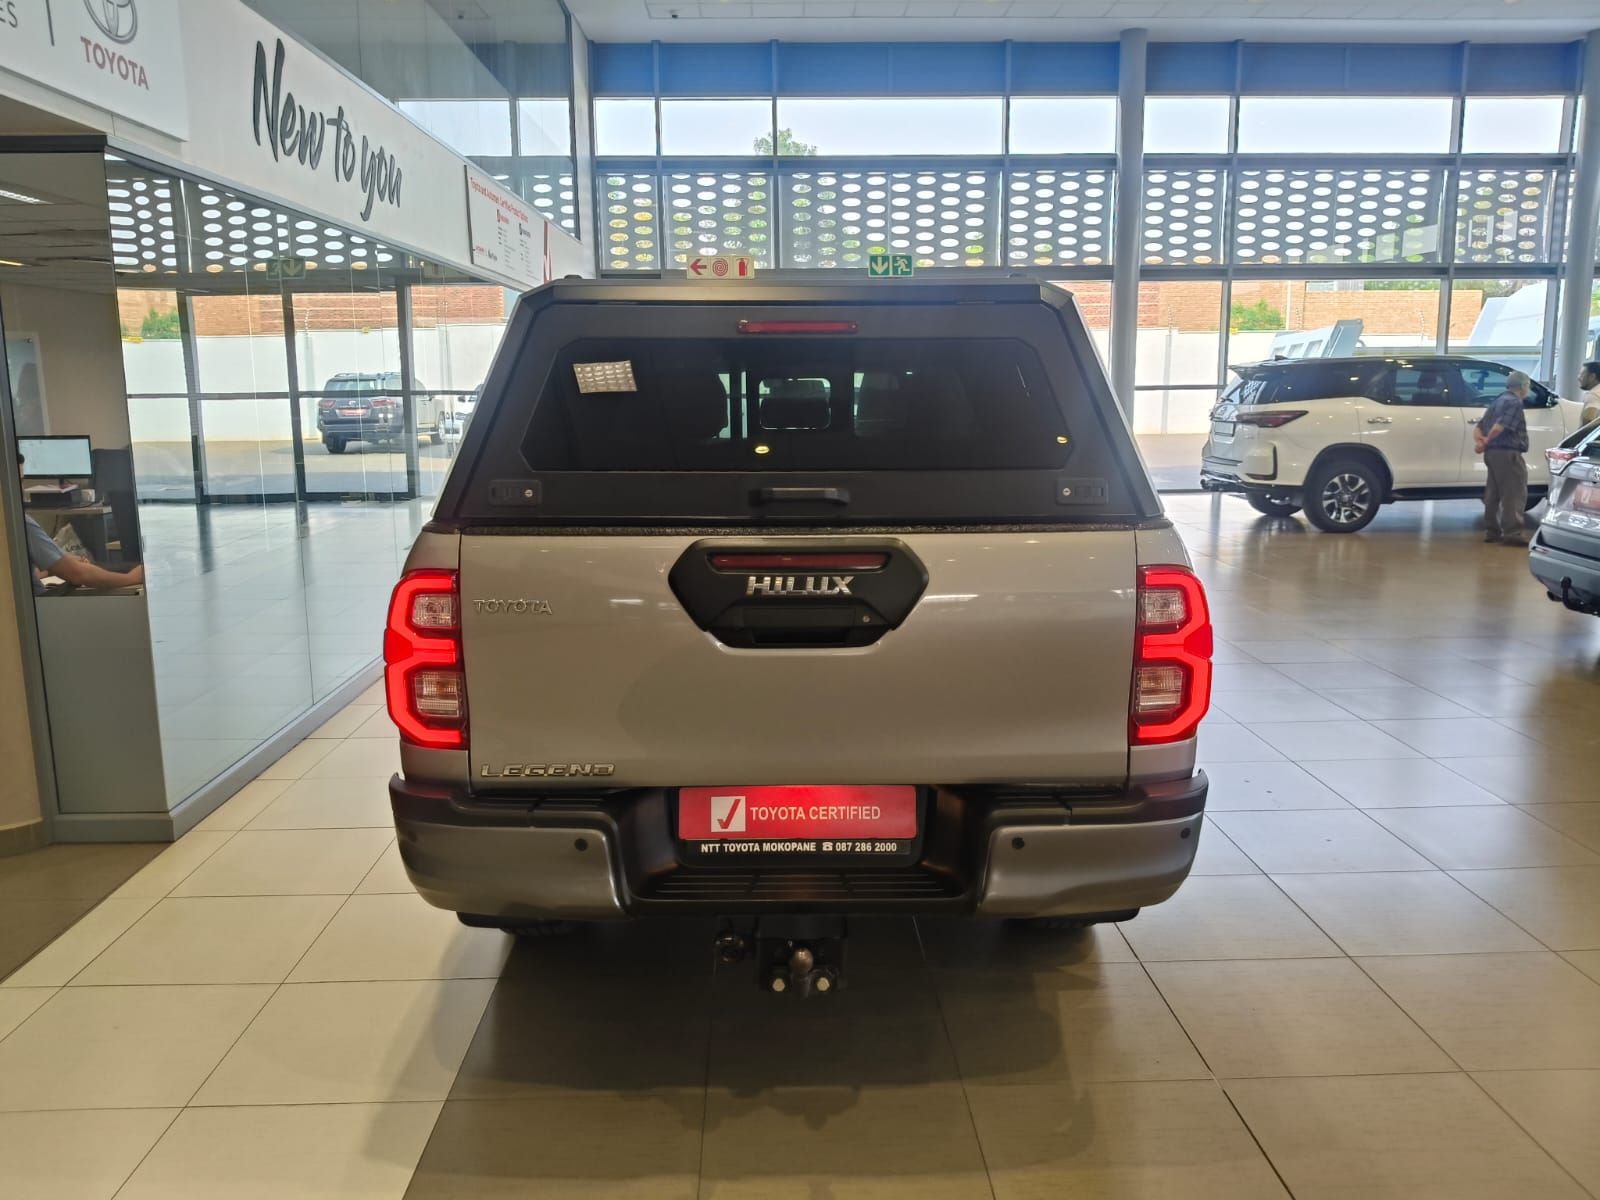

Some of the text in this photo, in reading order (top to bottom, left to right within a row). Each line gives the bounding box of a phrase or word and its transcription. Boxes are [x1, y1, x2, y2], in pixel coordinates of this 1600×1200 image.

[80, 36, 149, 90] TOYOTA
[253, 38, 325, 170] New
[326, 105, 356, 183] to
[360, 135, 403, 222] you
[746, 575, 854, 596] HILUX
[472, 598, 553, 615] TOYOTA
[480, 763, 616, 778] LEGEND
[749, 805, 881, 821] TOYOTA CERTIFIED
[701, 841, 897, 854] NTT TOYOTA MOKOPANE 087 286 2000
